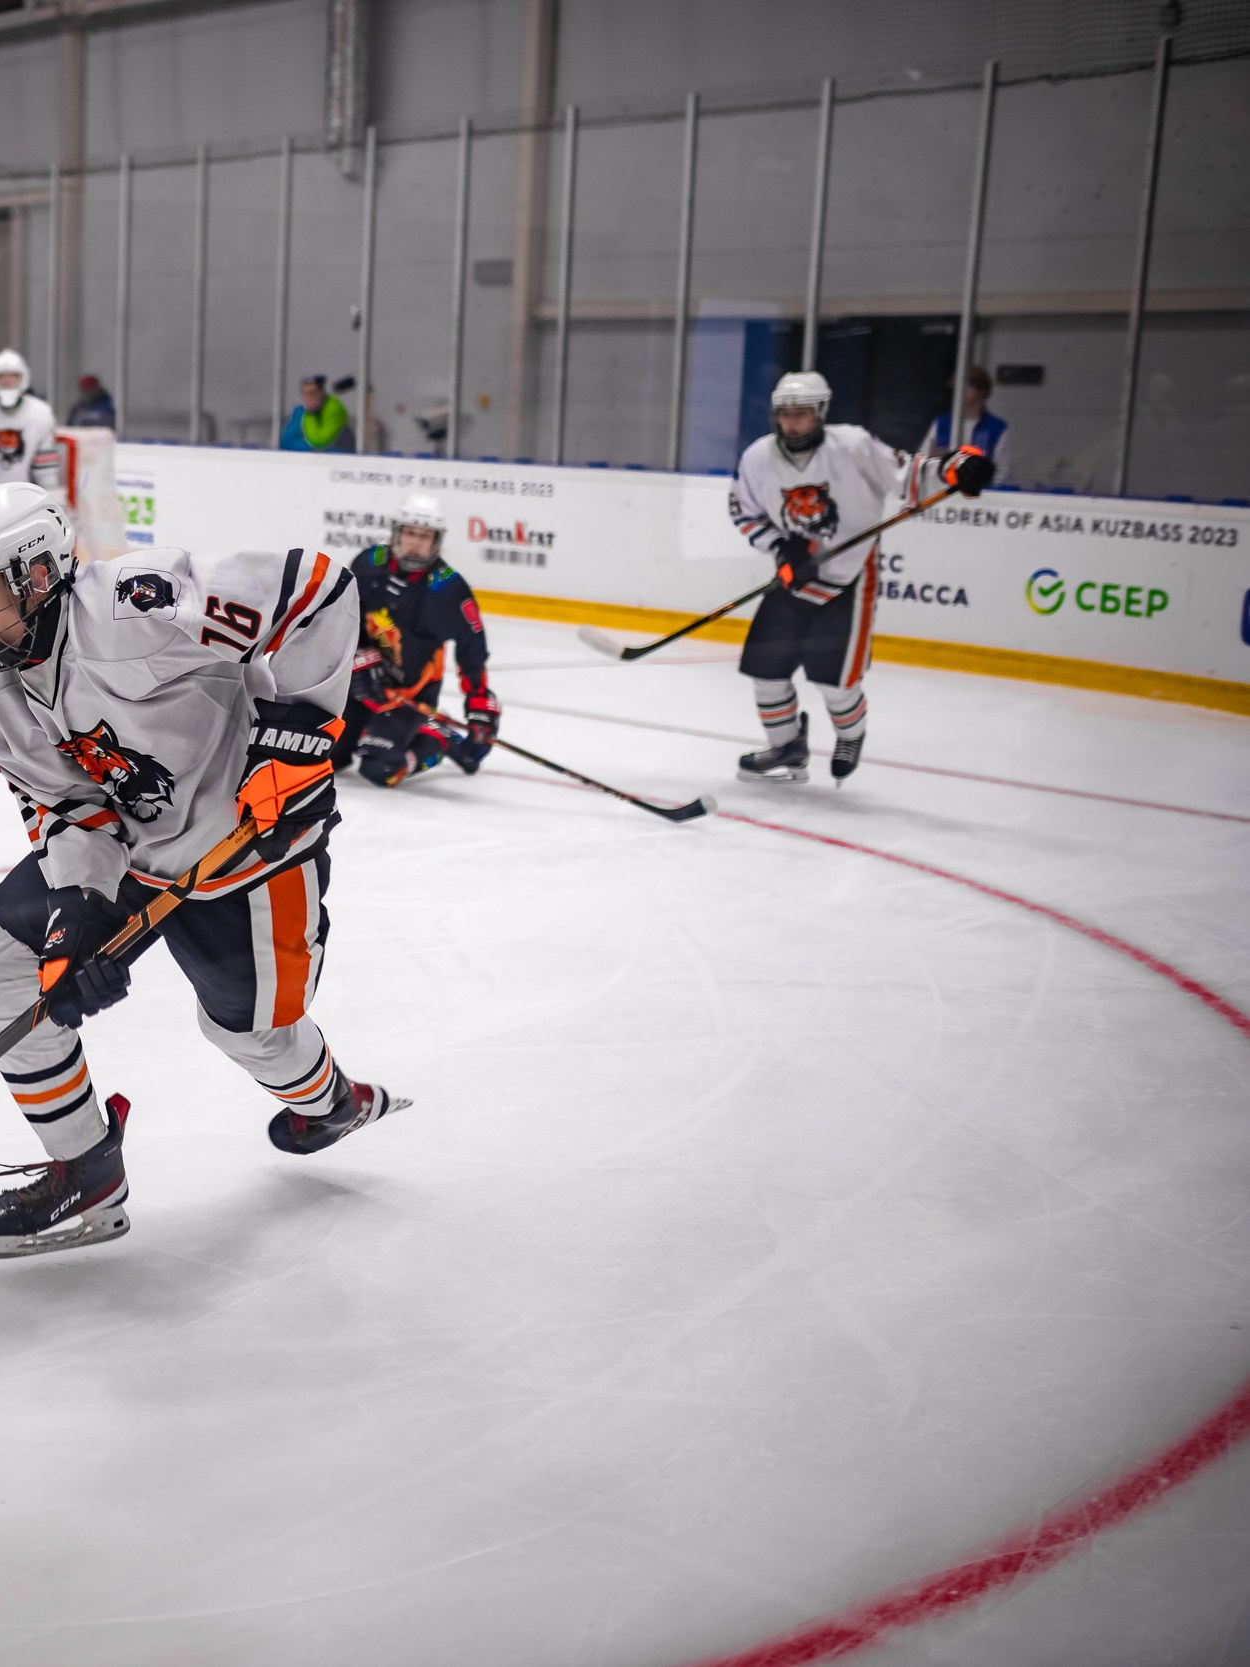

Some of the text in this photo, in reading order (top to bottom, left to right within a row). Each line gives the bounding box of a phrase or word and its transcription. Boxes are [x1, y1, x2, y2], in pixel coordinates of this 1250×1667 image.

[520, 483, 554, 498] 2023
[18, 534, 45, 553] CCM
[1005, 510, 1033, 530] OF
[1039, 514, 1083, 534] ASIA
[1091, 518, 1183, 543] KUZBASS
[1187, 525, 1239, 548] 2023
[1075, 581, 1169, 619] СБЕР
[200, 595, 262, 652] 16
[259, 727, 332, 757] АМУР
[51, 1190, 81, 1222] CCM
